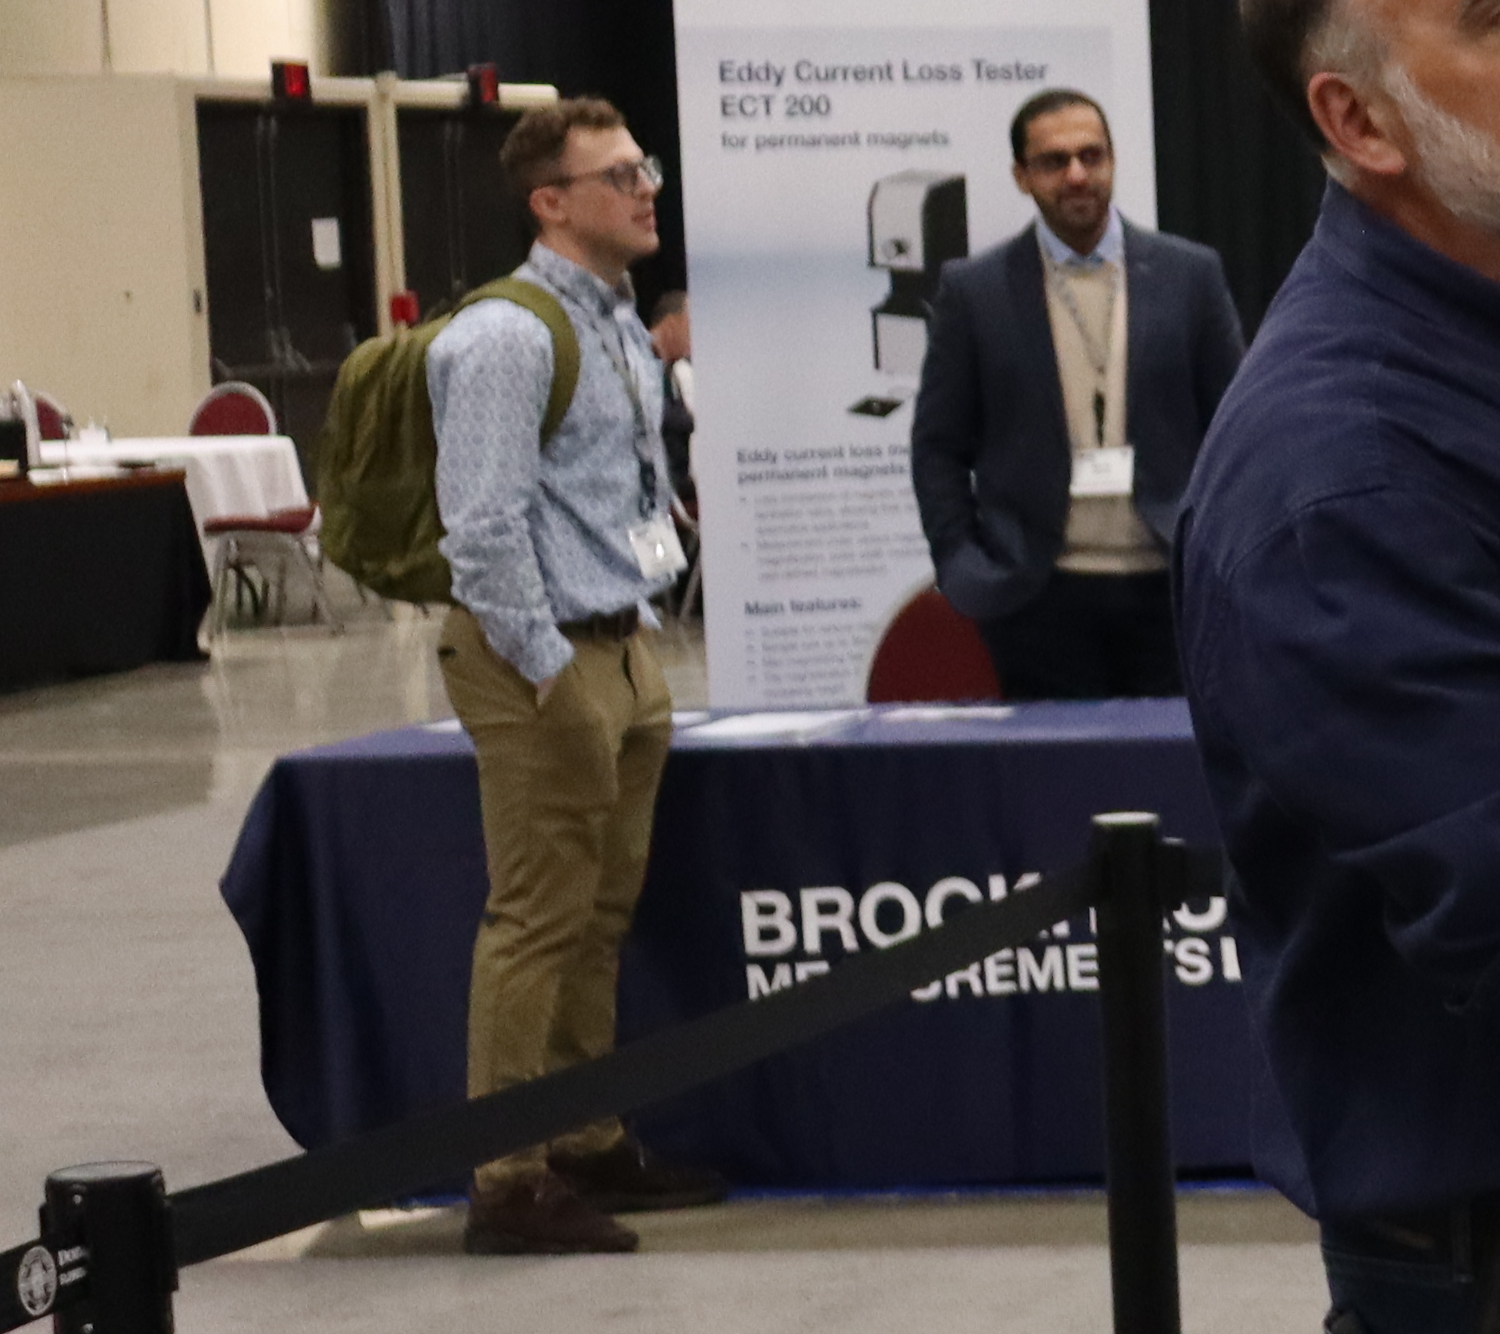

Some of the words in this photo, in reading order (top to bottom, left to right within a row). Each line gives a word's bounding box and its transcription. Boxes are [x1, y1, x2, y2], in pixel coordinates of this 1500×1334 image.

[719, 61, 785, 86] Eddy
[794, 60, 893, 83] Current
[902, 59, 963, 81] Loss
[972, 58, 1048, 81] Tester
[721, 96, 776, 117] ECT
[785, 95, 831, 117] 200
[721, 131, 746, 148] for
[755, 131, 860, 152] permanent
[866, 129, 949, 149] magnets
